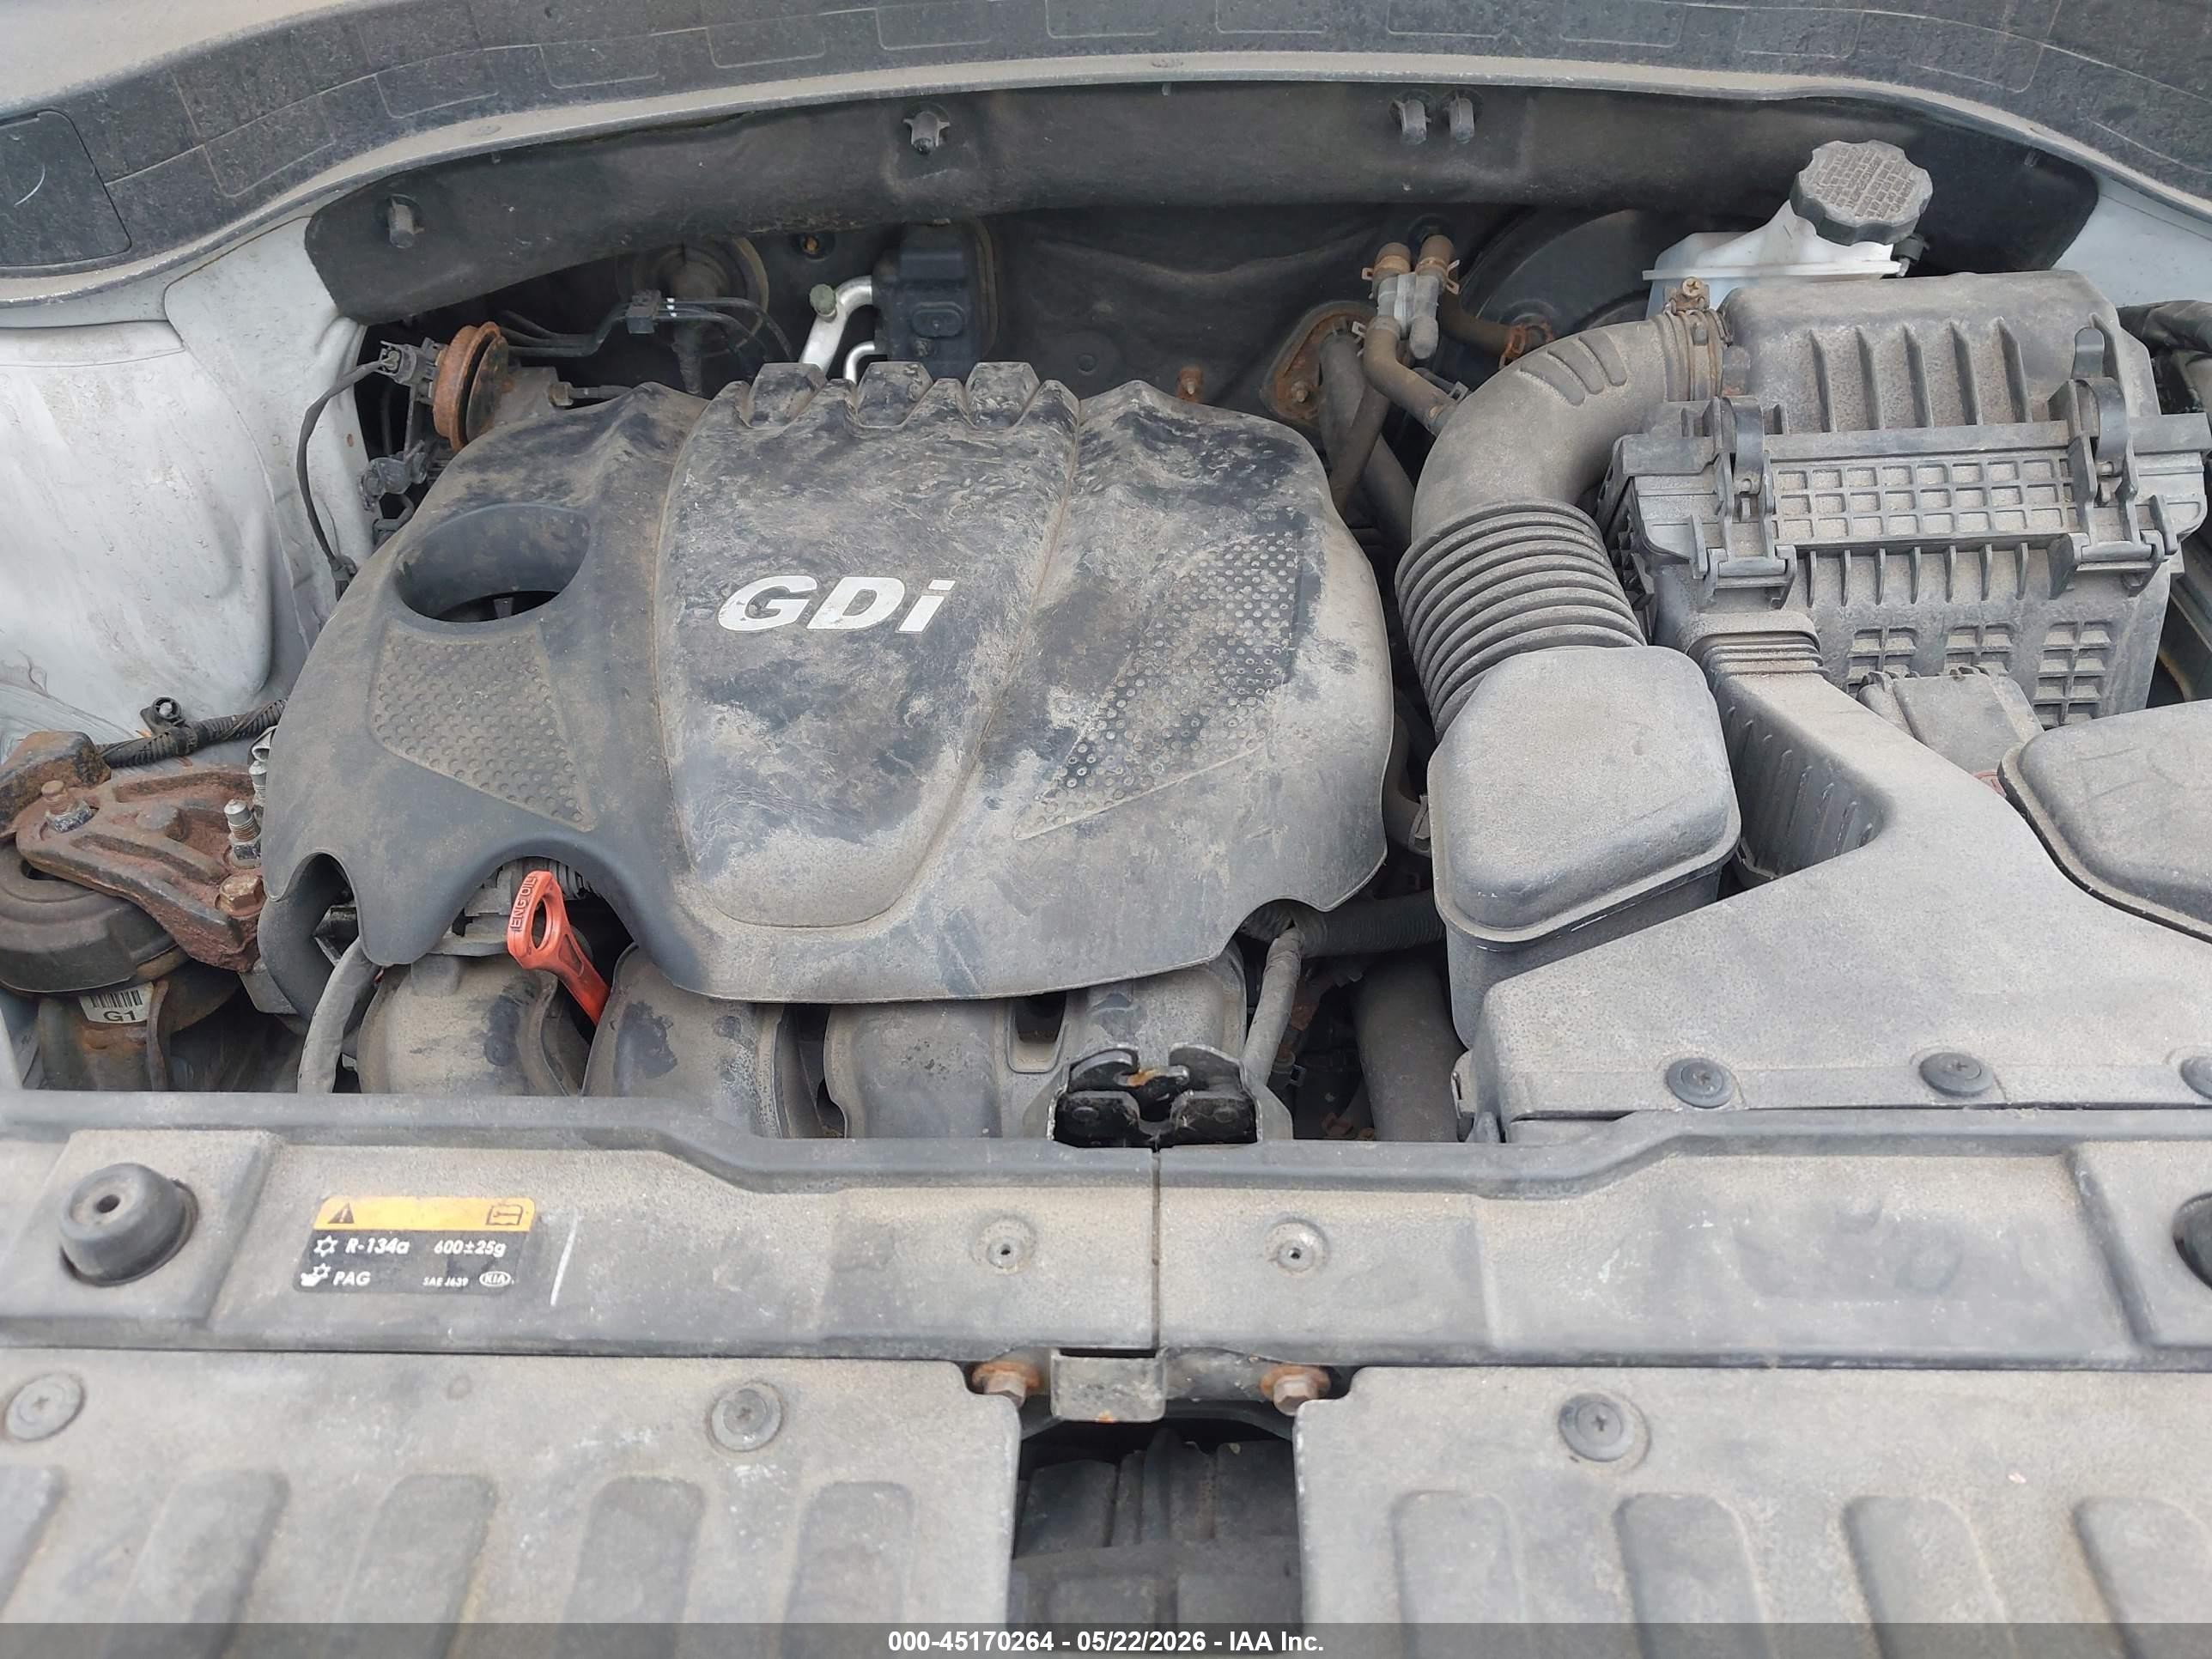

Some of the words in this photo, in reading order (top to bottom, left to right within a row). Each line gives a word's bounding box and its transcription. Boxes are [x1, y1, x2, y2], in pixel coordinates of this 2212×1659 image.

[718, 575, 956, 631] GDi
[510, 899, 527, 928] ENG
[520, 876, 537, 896] OIL
[103, 1010, 136, 1022] G1
[345, 1237, 410, 1255] R-134a
[434, 1239, 507, 1257] 600±25g
[333, 1271, 371, 1286] PAG
[422, 1276, 444, 1287] SAE
[444, 1276, 469, 1287] J639
[482, 1273, 508, 1285] KIA
